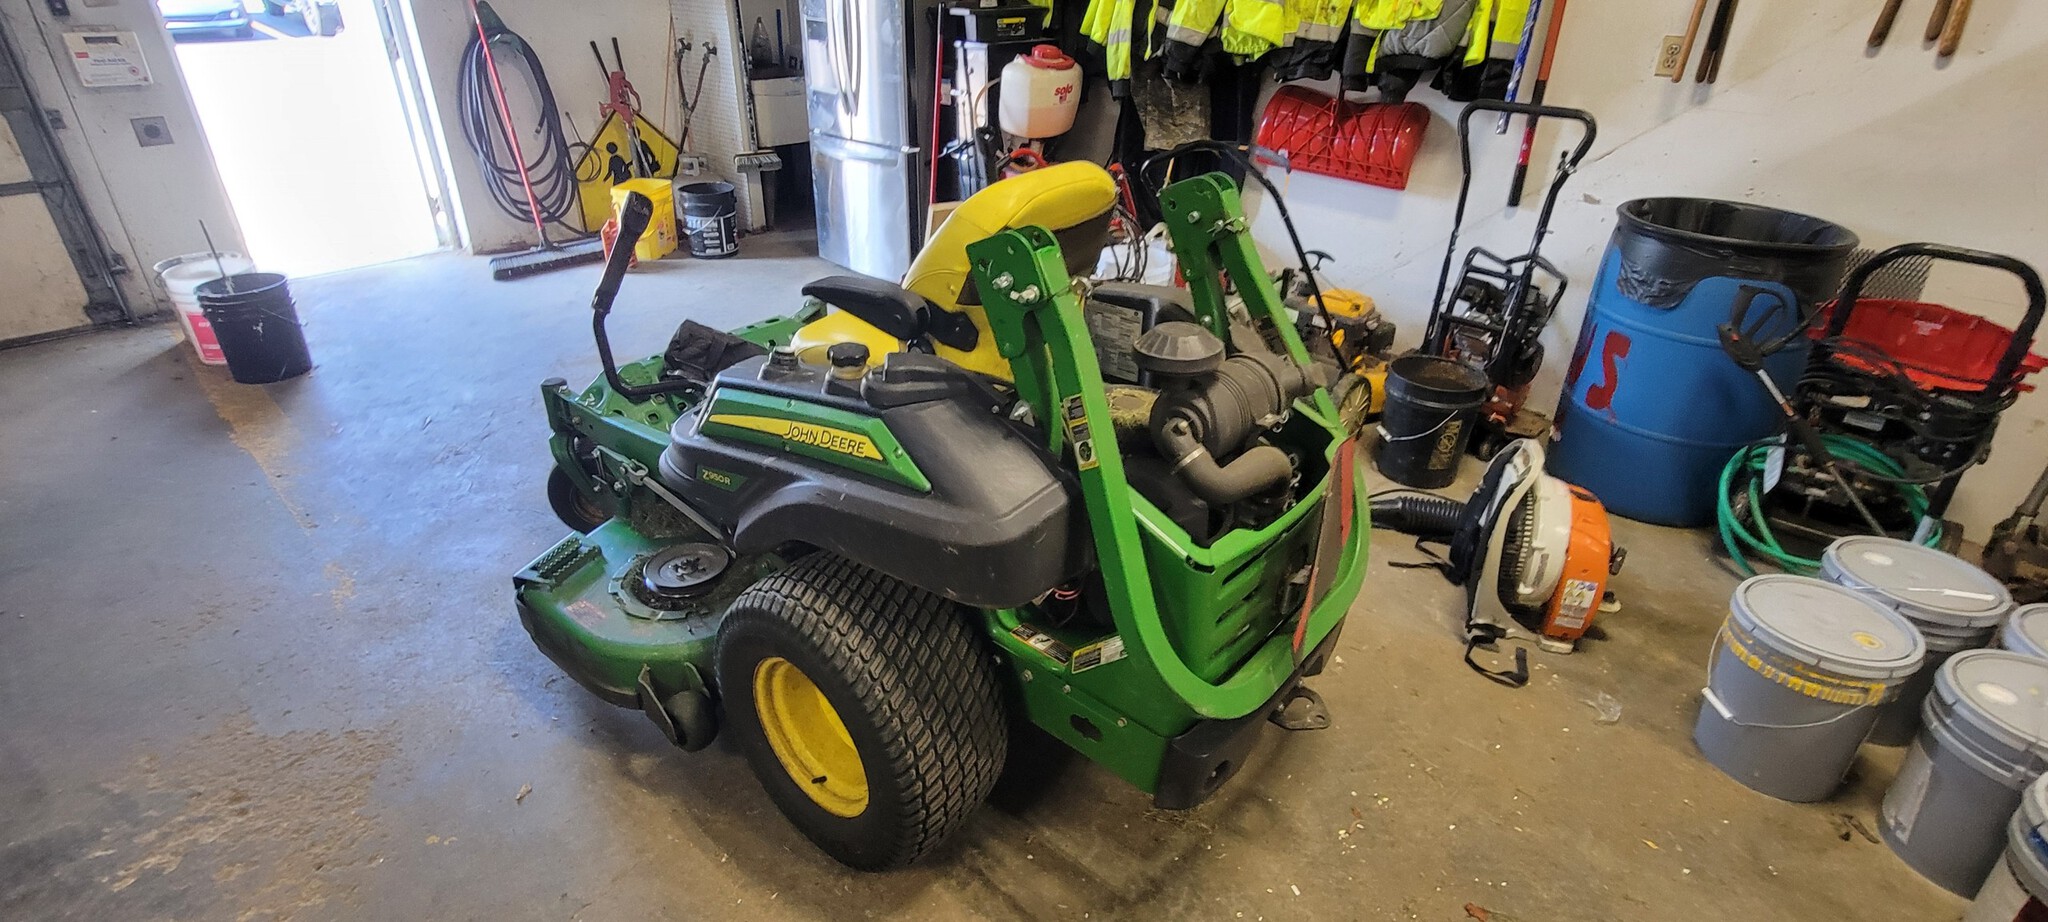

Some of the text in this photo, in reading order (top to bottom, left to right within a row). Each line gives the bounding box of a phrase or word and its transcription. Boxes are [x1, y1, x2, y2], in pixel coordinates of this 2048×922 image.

[1054, 83, 1073, 96] solo
[782, 422, 867, 454] JOHN DEERE
